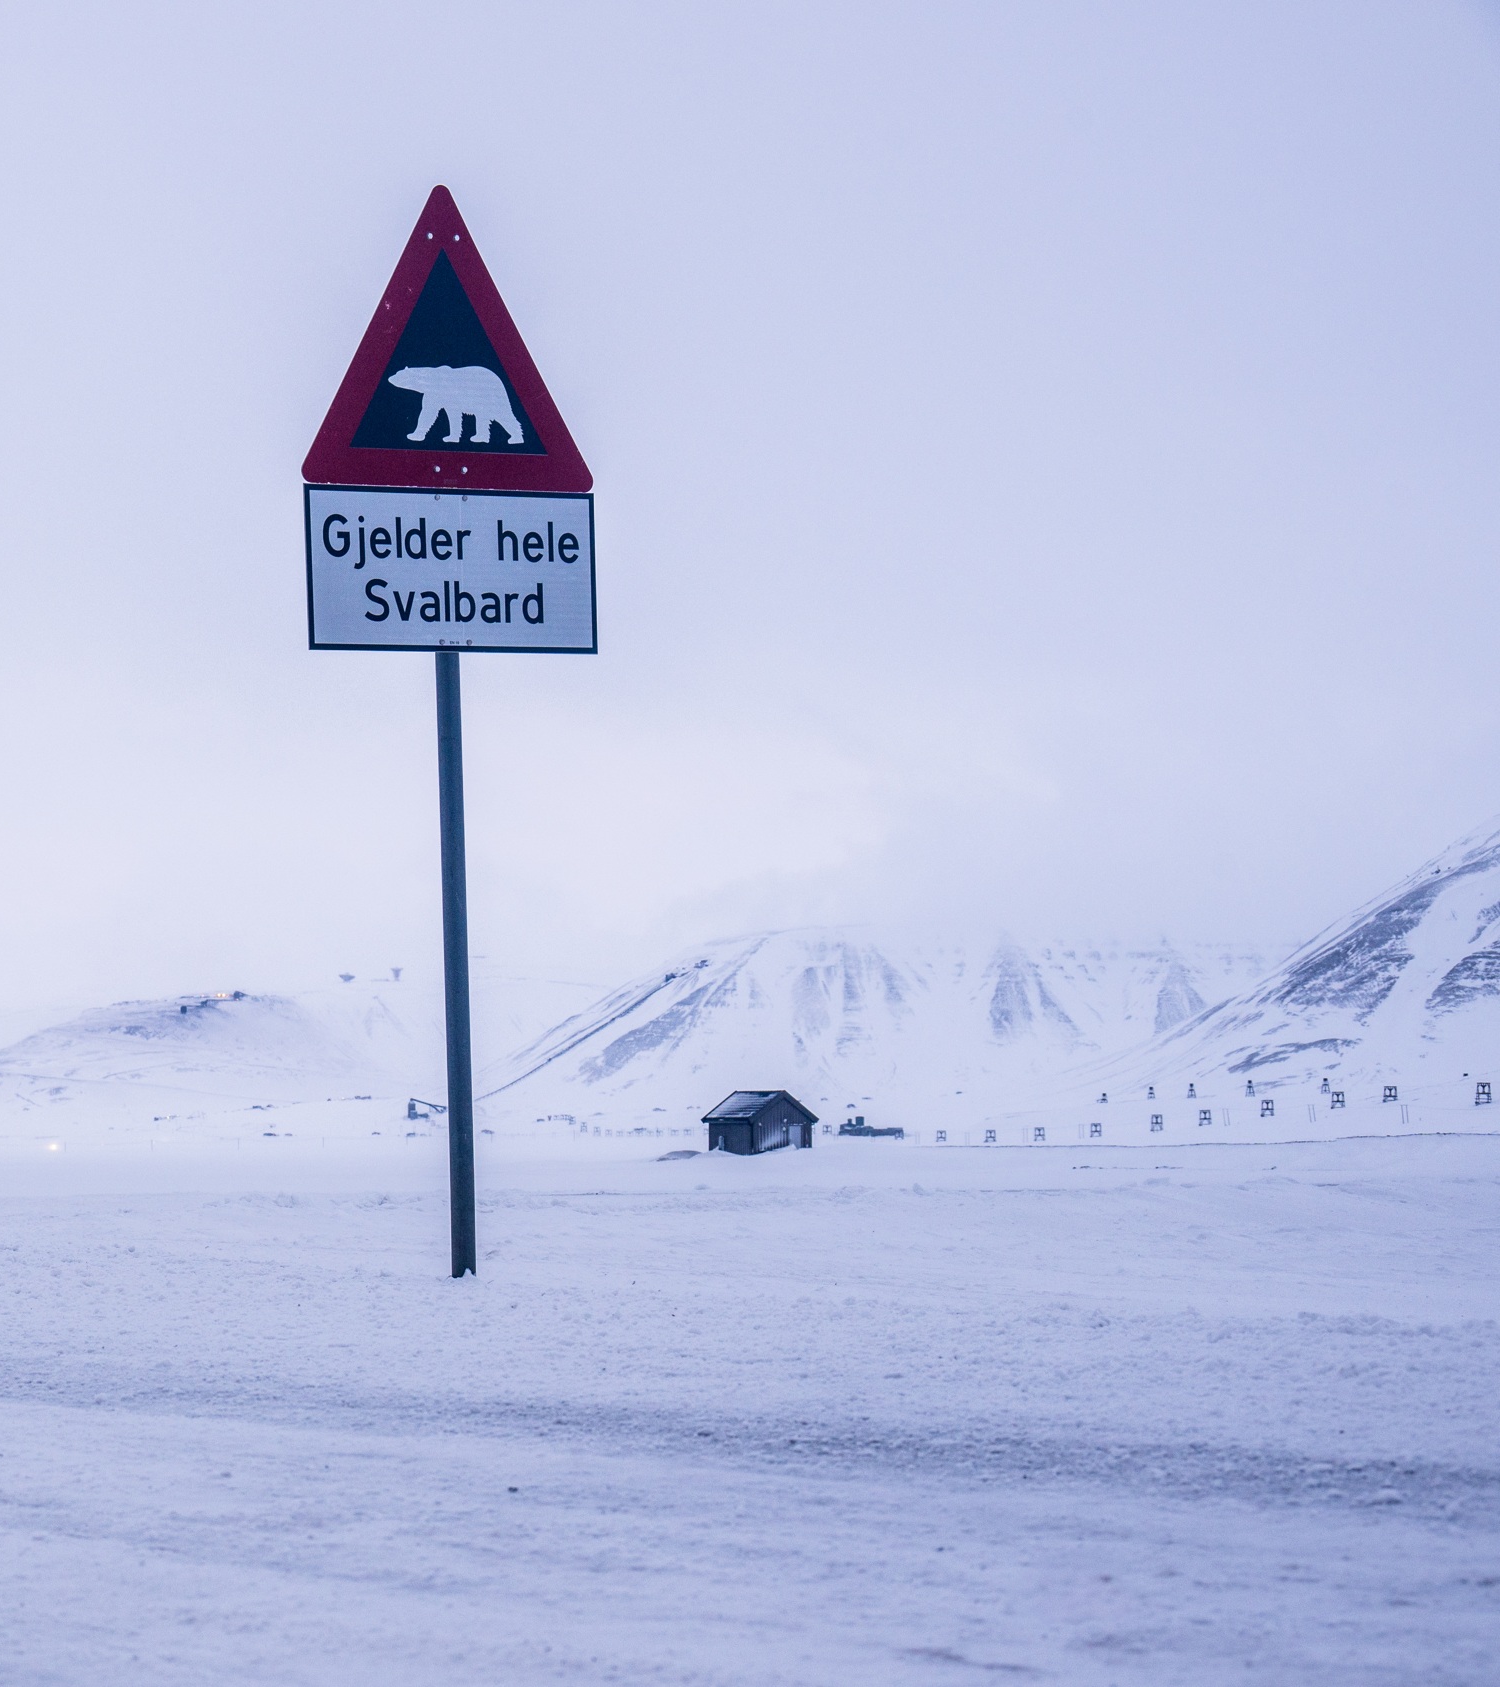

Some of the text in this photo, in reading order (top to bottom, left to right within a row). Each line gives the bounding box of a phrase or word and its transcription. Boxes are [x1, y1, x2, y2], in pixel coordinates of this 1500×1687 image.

[322, 514, 580, 569] Gjelder hele
[364, 578, 545, 624] Svalbard
